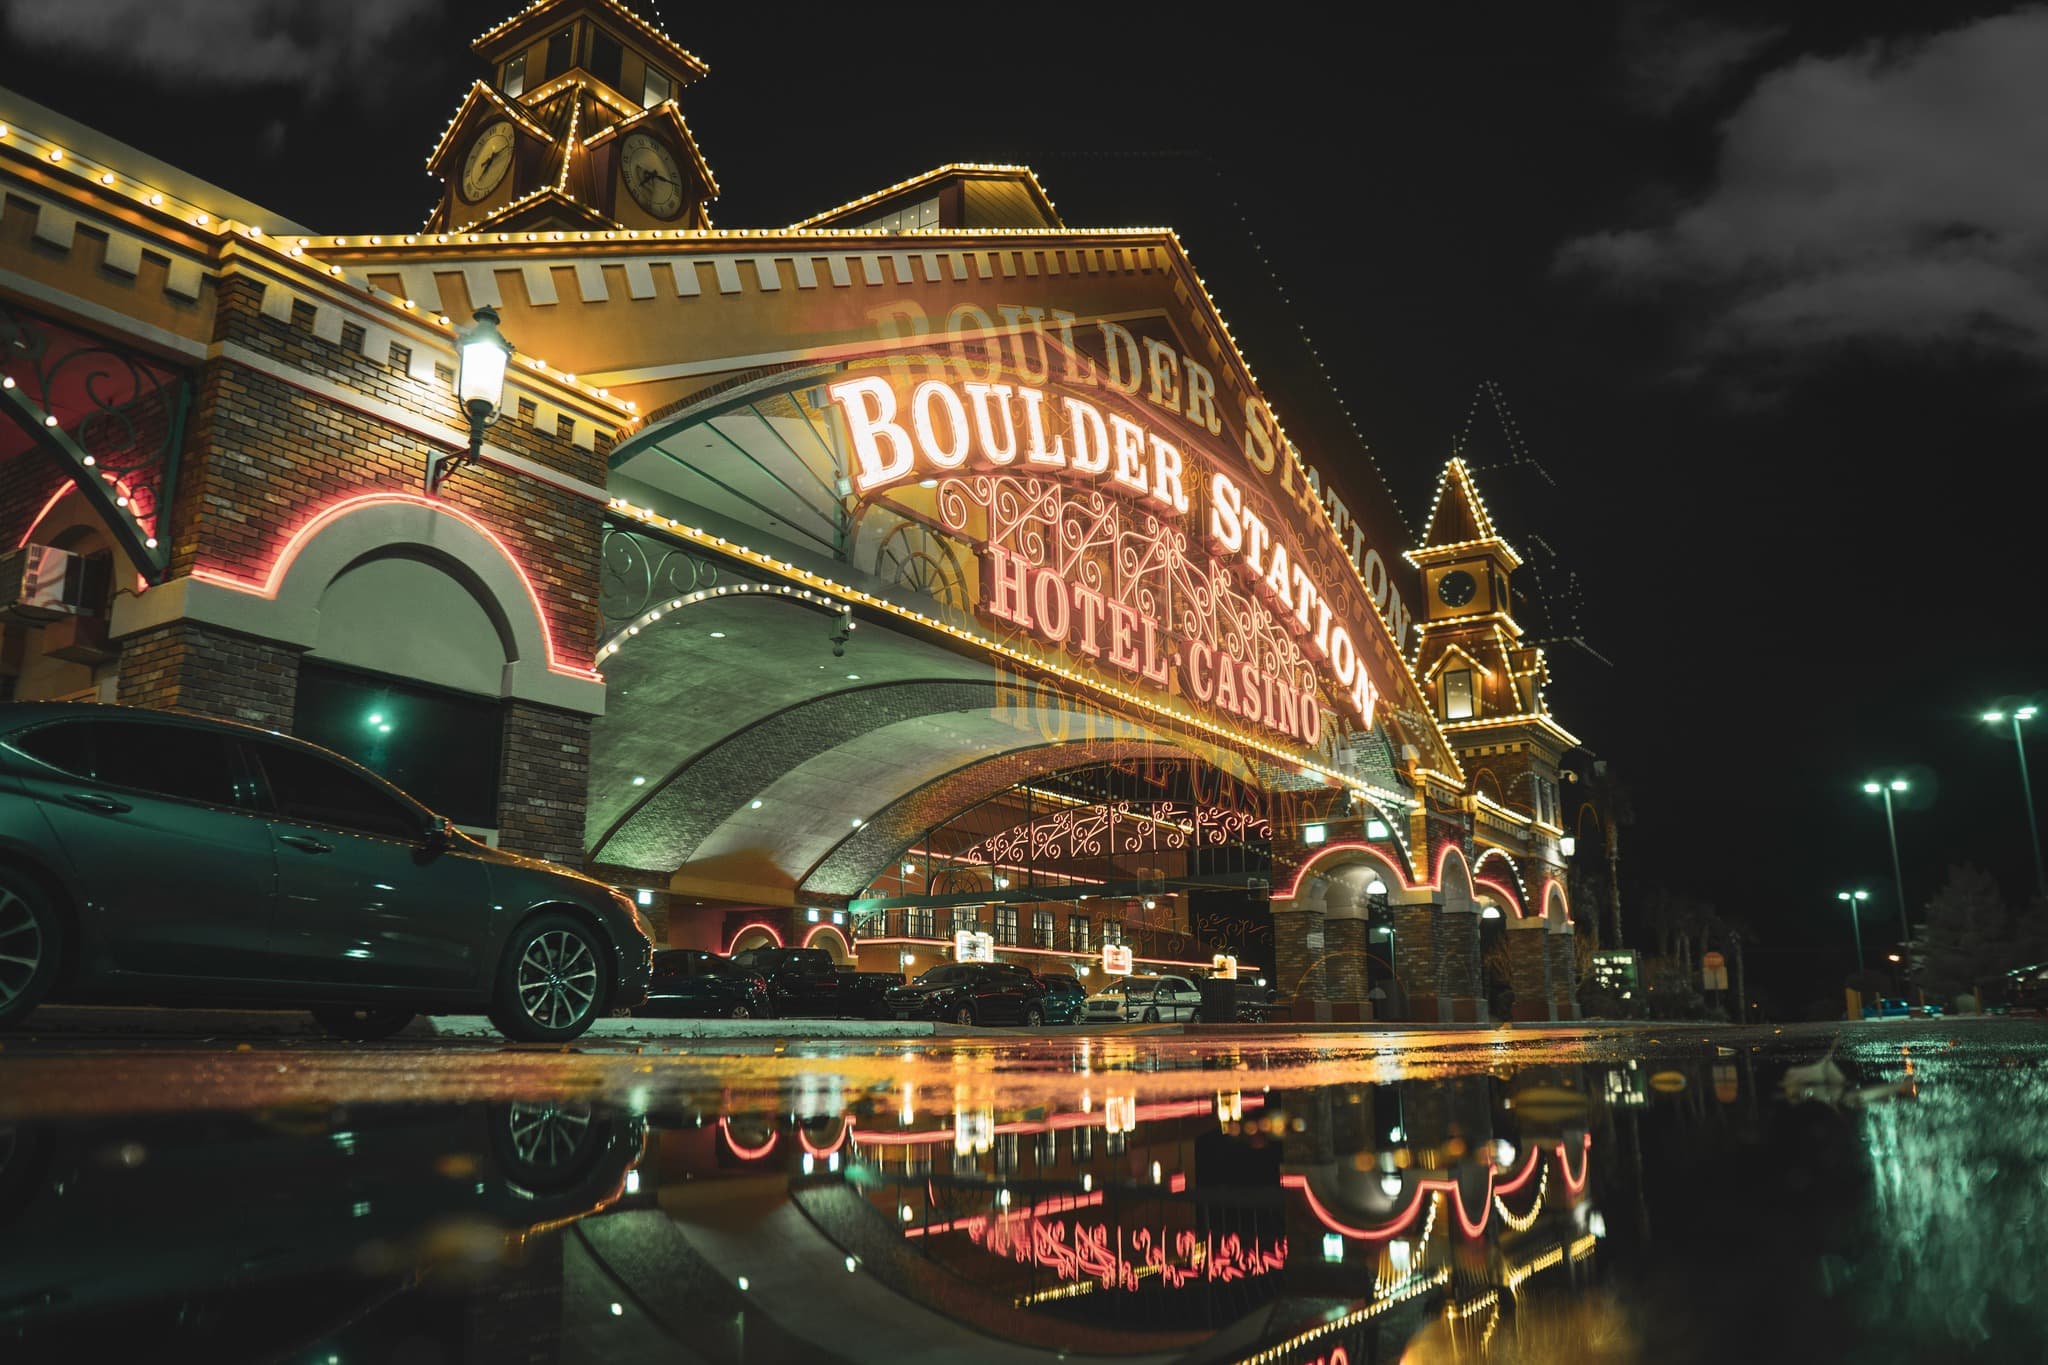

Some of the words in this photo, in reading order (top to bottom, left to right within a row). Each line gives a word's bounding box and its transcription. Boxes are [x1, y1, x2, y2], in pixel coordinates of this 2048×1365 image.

[829, 374, 1189, 515] BOULDER
[1210, 472, 1379, 731] STATION
[988, 544, 1169, 685] HOTEL
[1189, 639, 1322, 746] CASINO
